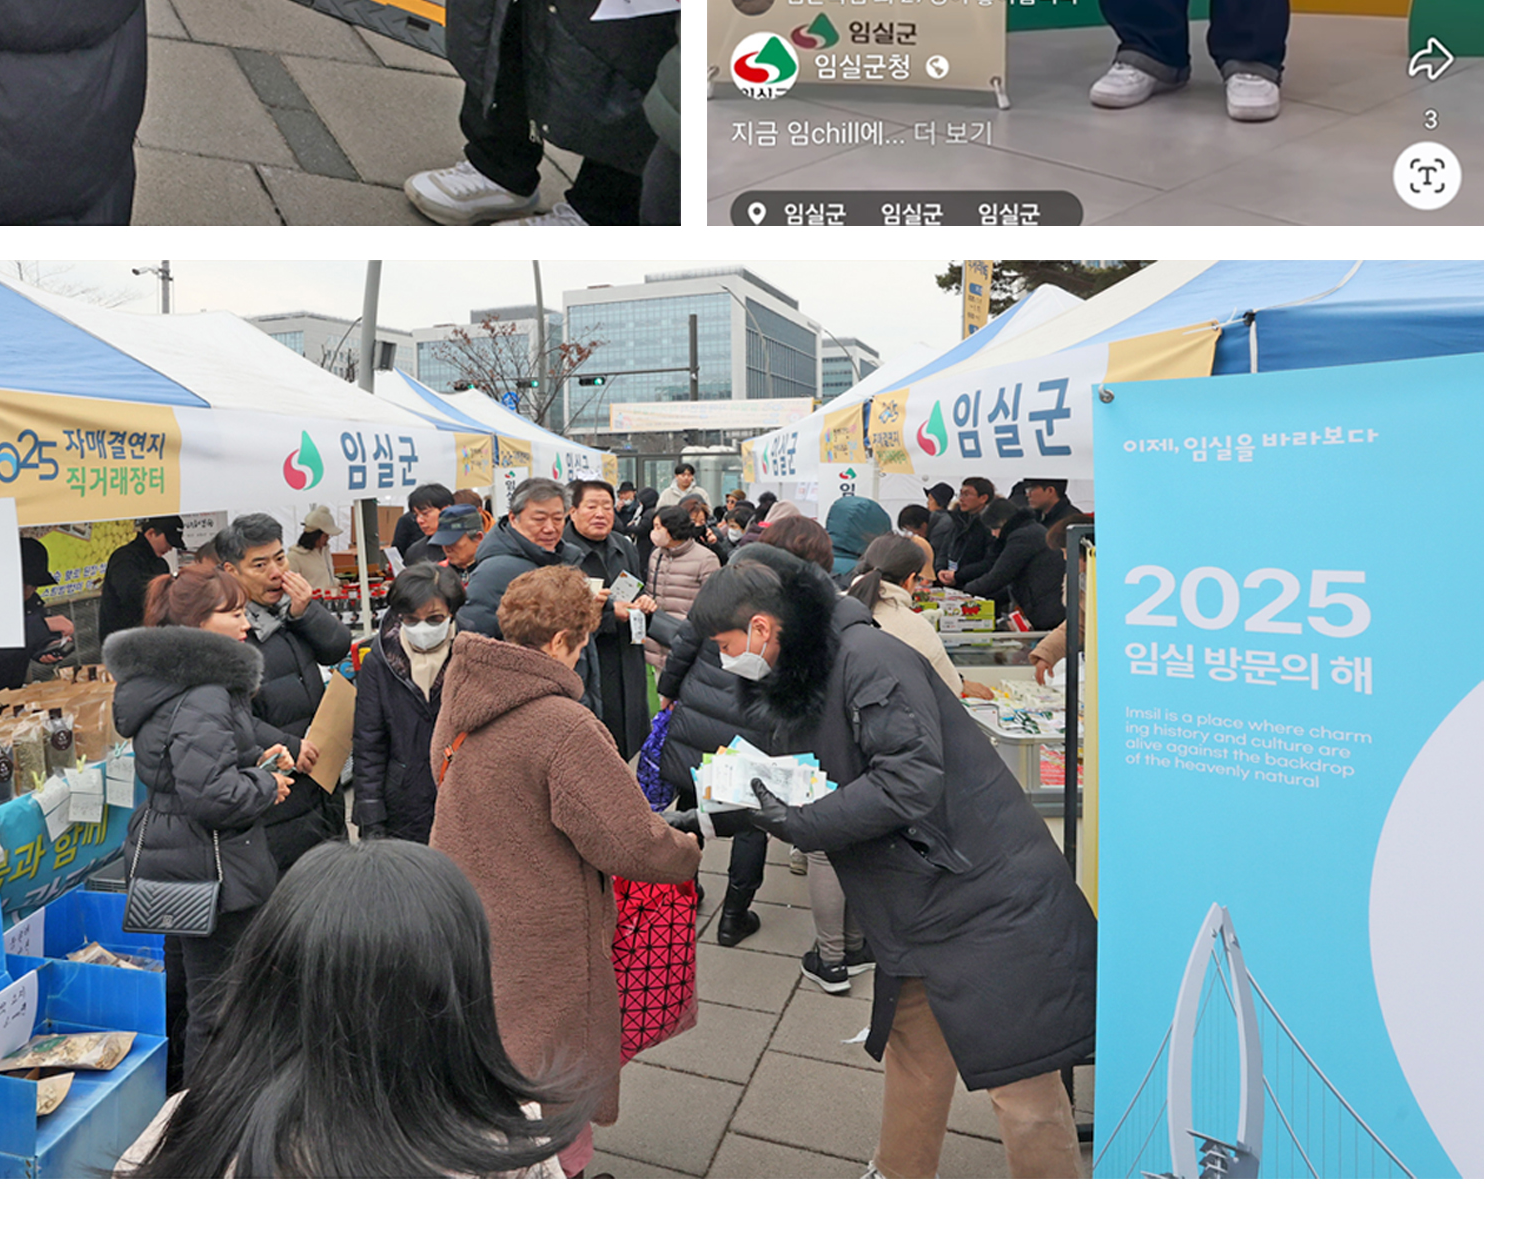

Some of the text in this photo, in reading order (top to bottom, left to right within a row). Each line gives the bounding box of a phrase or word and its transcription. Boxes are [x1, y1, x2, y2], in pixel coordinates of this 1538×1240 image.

[848, 21, 918, 46] 임실군
[814, 54, 911, 80] 임실군청
[731, 121, 993, 147] 지금 더 보기
[784, 204, 1041, 226] 임실군 임실군 임실군
[953, 377, 1073, 459] 임실군
[62, 427, 167, 460] 자매결연지
[340, 431, 419, 491] 임실군
[770, 432, 799, 477] 임실군
[1183, 426, 1379, 463] 임실을 바라보다
[65, 464, 166, 498] 직거래장터
[1123, 564, 1372, 638] 2025
[1124, 641, 1373, 696] 임실 방문의 해
[1125, 706, 1373, 744] Imsil a place where charm
[1125, 722, 1352, 759] ing history and culture are
[1125, 737, 1356, 777] alive against the backdrop
[1125, 752, 1320, 789] of the heavenly natural
